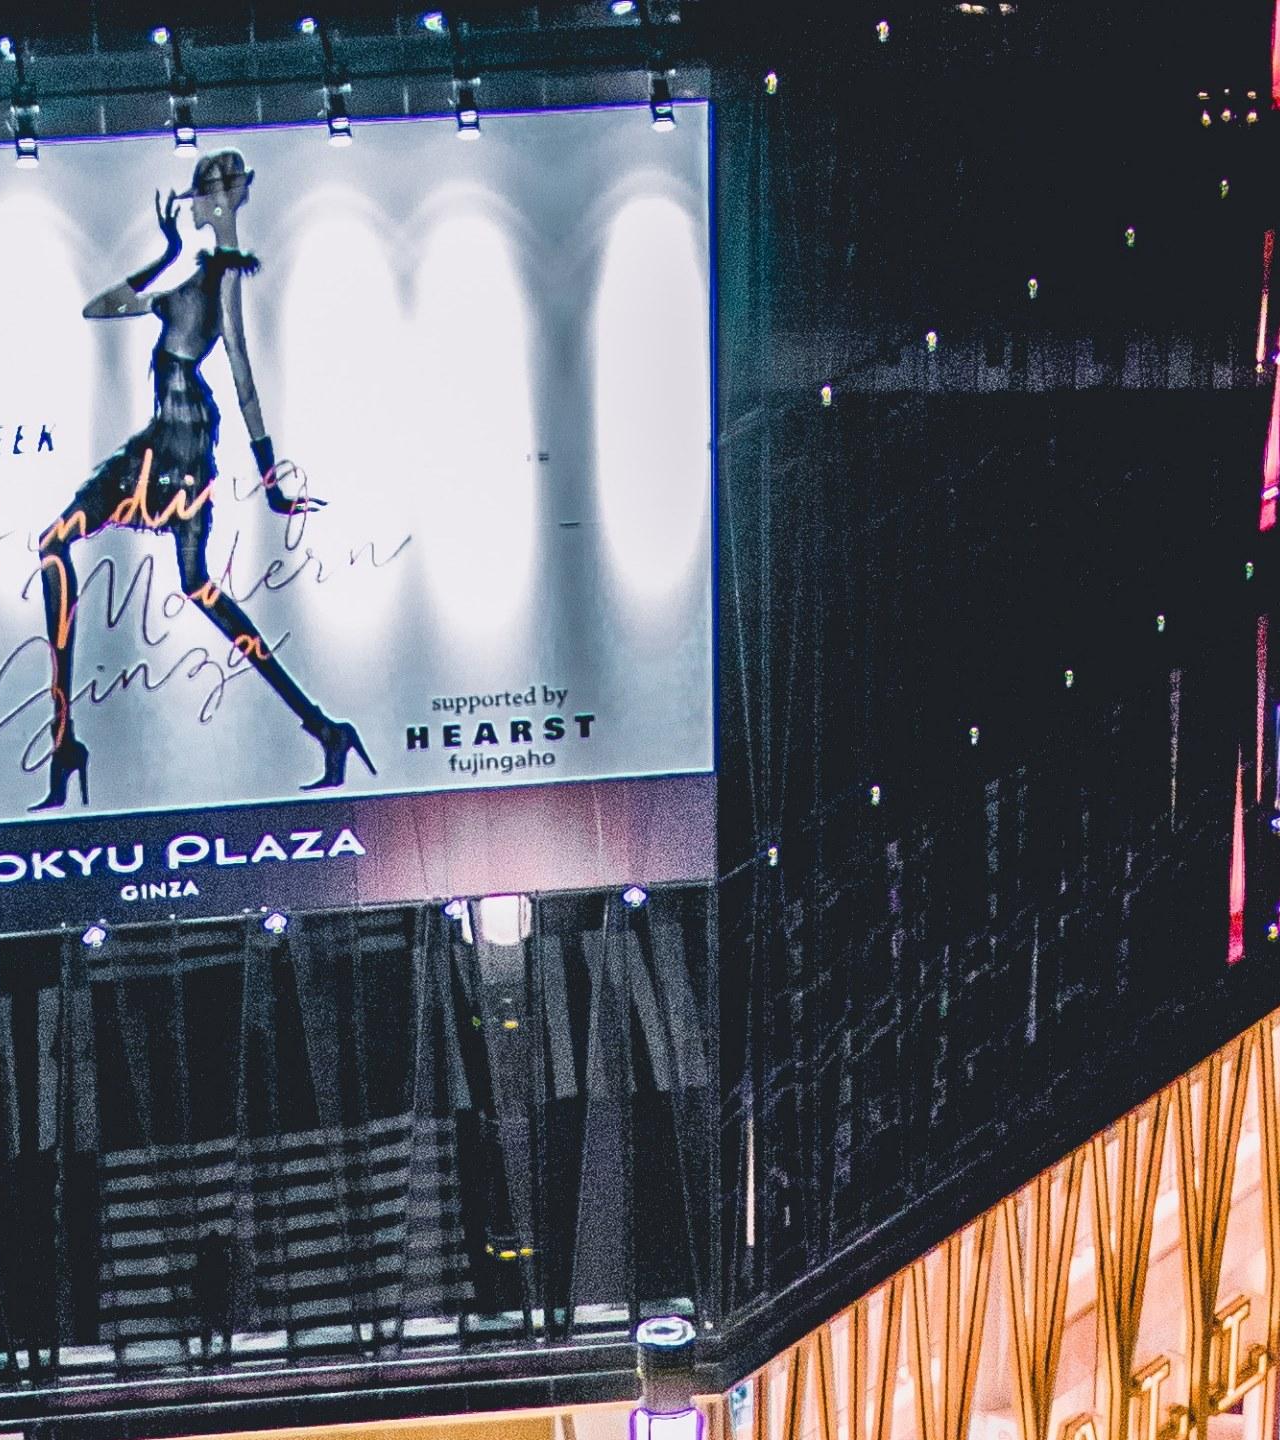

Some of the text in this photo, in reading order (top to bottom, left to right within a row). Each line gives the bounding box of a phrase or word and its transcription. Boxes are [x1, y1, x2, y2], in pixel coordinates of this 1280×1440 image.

[432, 685, 569, 716] supported by
[406, 714, 596, 750] HEARST
[448, 750, 556, 777] fujingaho
[168, 829, 366, 869] PLAZA
[120, 881, 199, 901] GINZA
